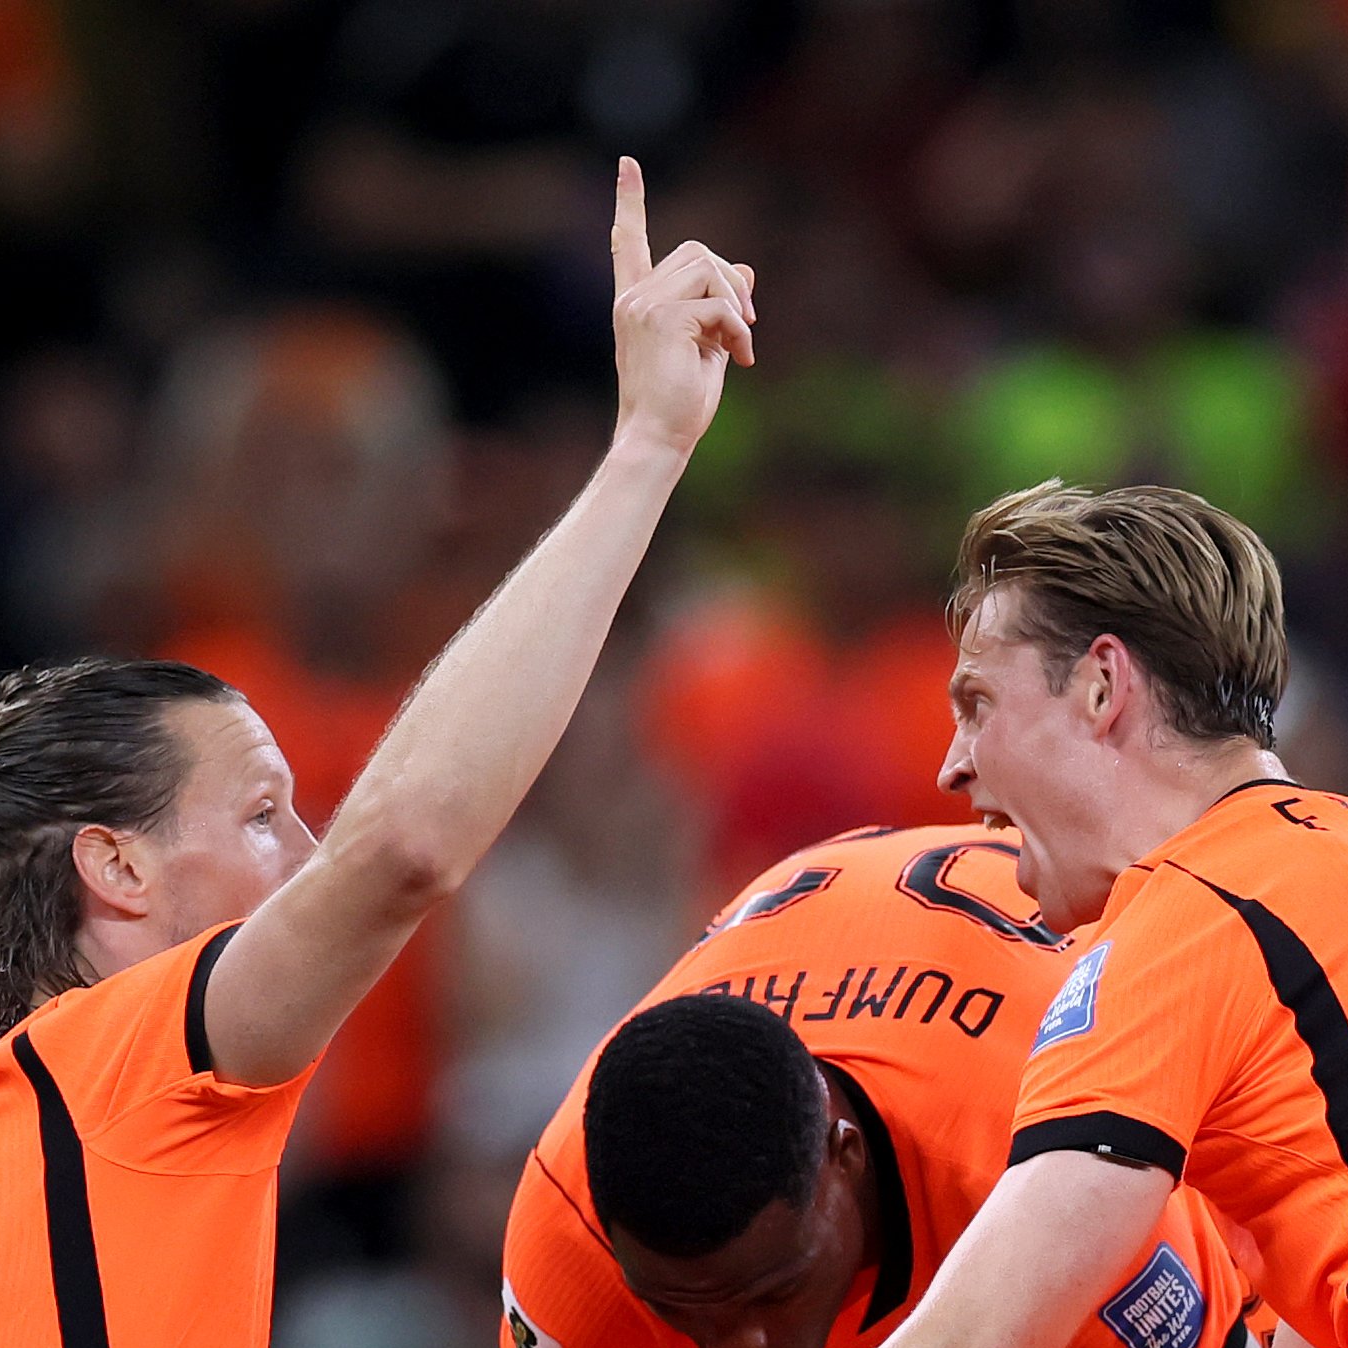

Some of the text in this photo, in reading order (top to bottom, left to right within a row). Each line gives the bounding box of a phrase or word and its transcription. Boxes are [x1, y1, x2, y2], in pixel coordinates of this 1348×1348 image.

[1122, 1268, 1175, 1325] FOOTBALL
[1134, 1278, 1186, 1338] UNITES
[1166, 1288, 1196, 1336] World
[1171, 1324, 1192, 1348] FIFA
